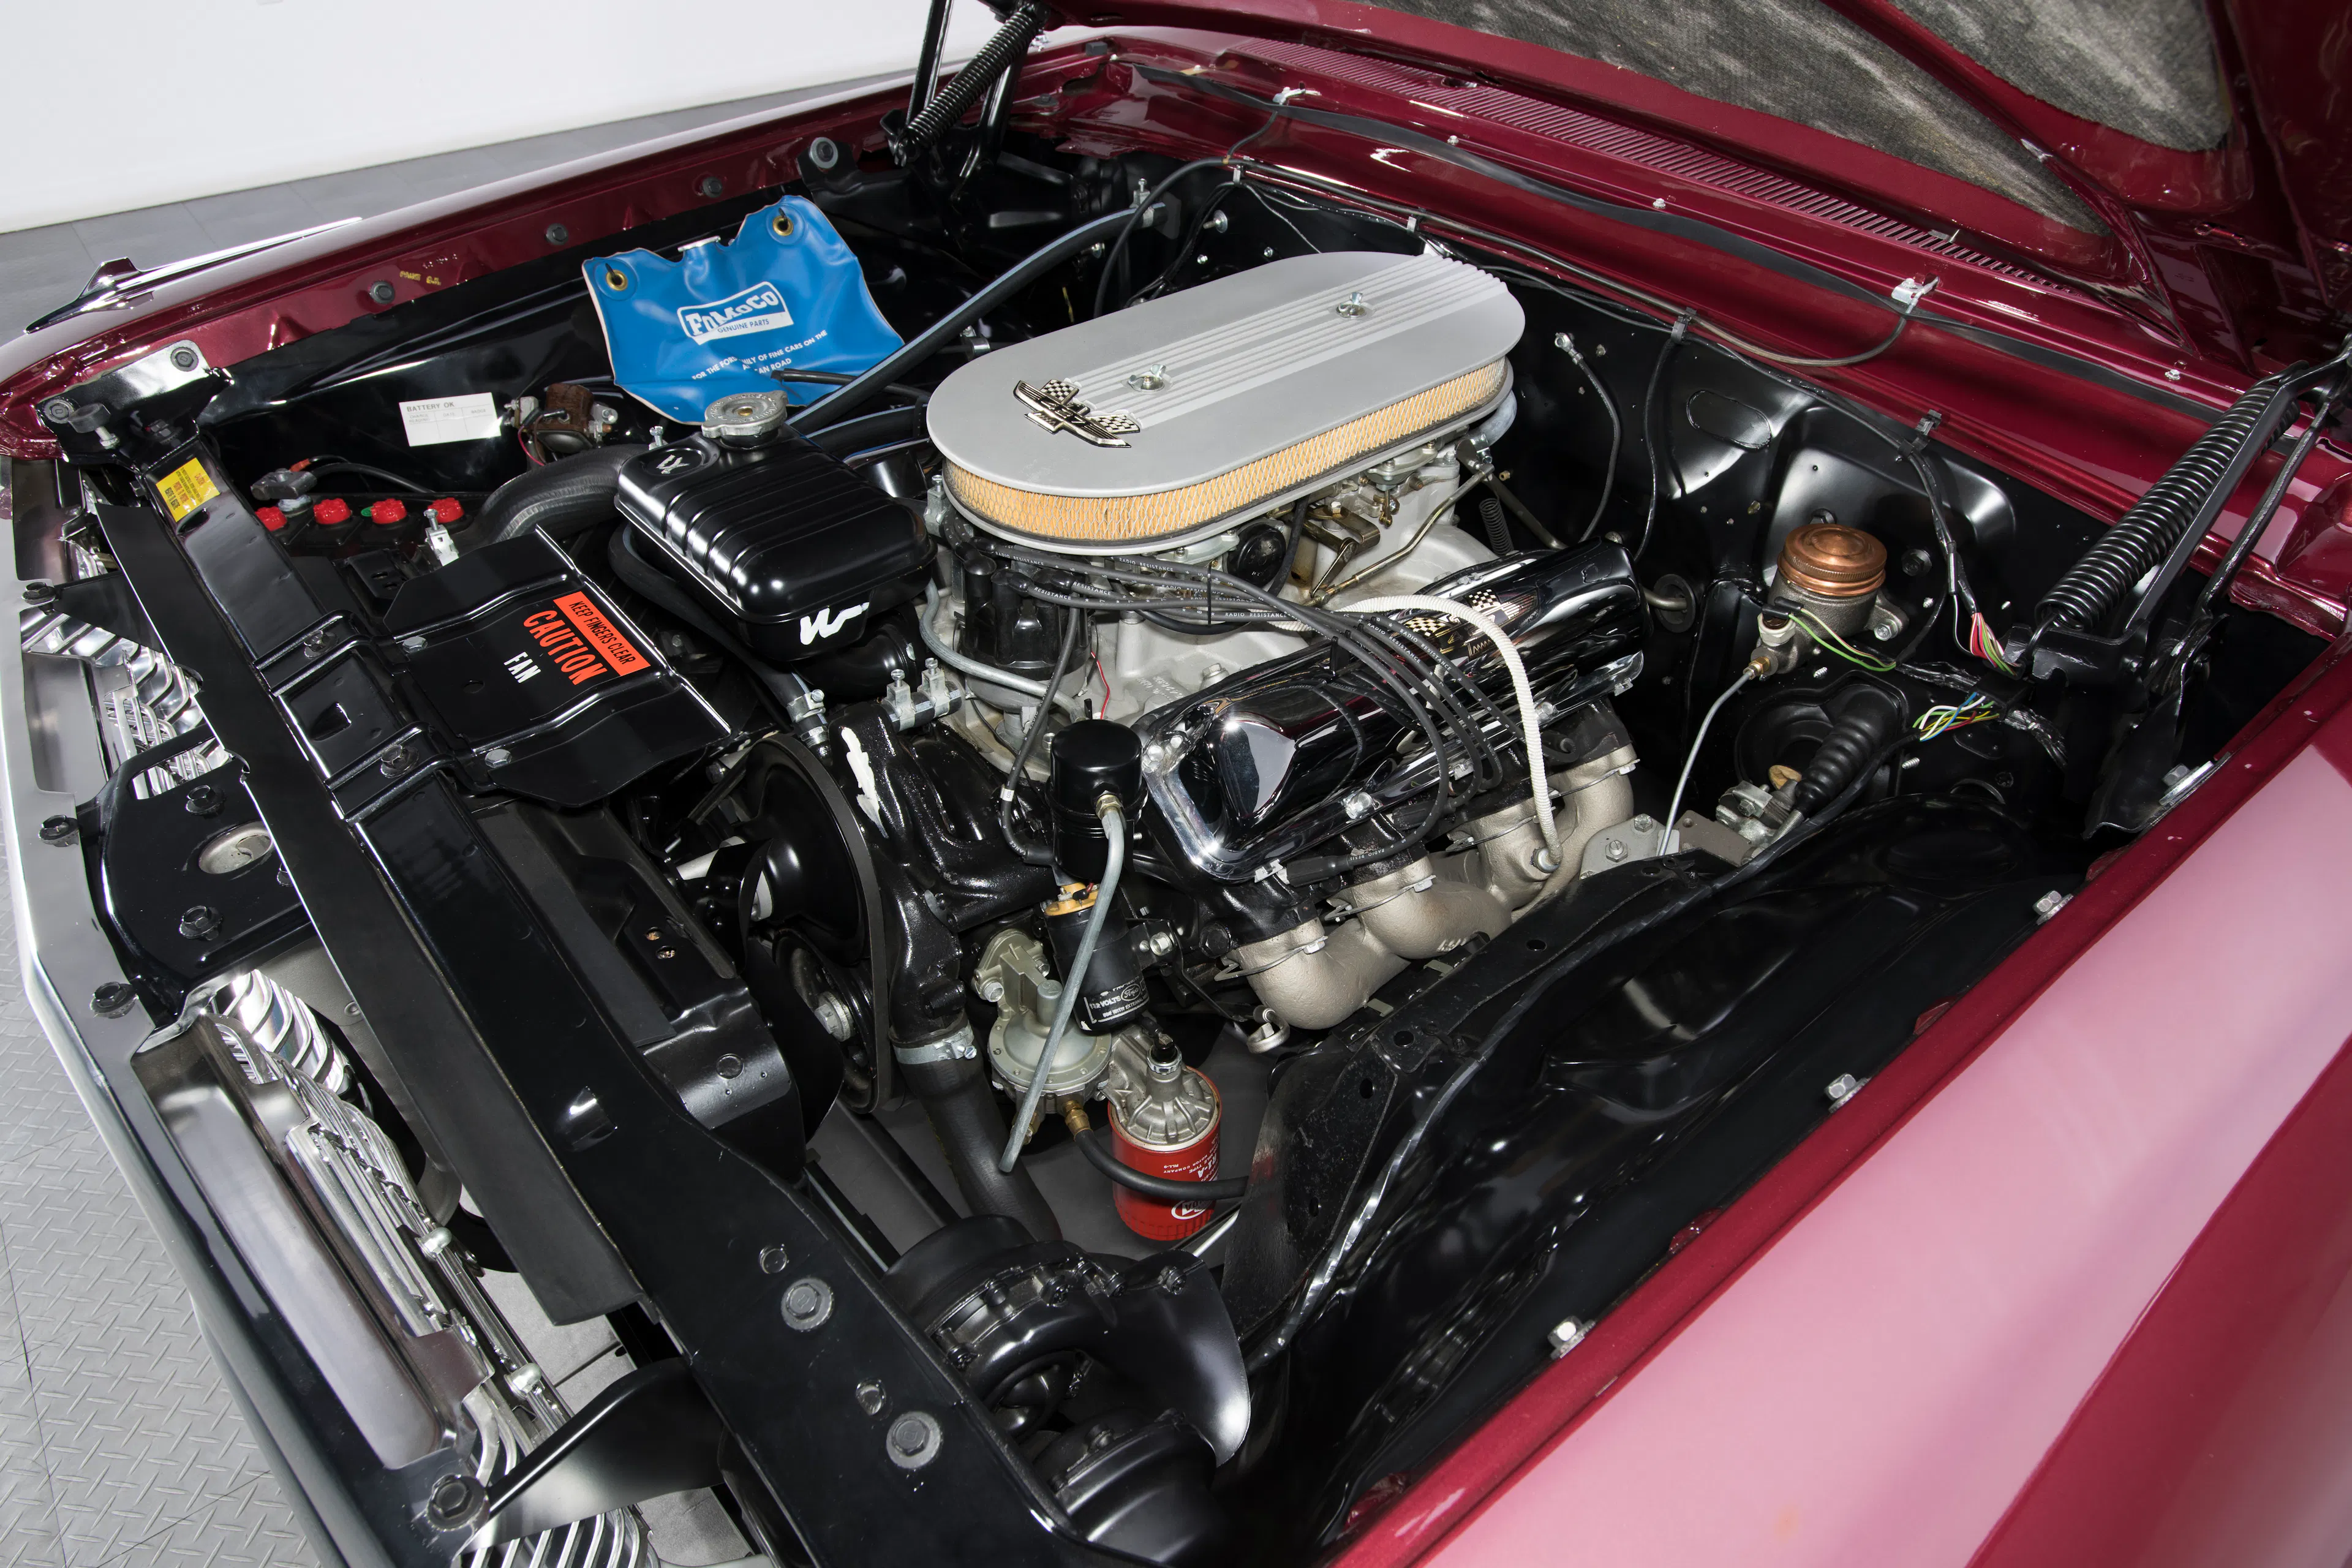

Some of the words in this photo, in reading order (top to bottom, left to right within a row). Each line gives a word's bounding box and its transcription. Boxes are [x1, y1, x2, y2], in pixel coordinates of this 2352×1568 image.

[717, 322, 748, 333] GENUINE
[750, 318, 769, 328] PARTS
[706, 363, 720, 375] THE
[768, 349, 785, 360] FINE
[785, 342, 803, 353] CARS
[804, 337, 815, 346] ON
[815, 330, 827, 341] THE
[770, 358, 792, 371] ROAD
[407, 403, 440, 412] BATTERY
[1013, 556, 1044, 566] RESISTANCE
[1140, 562, 1174, 572] RESISTANCE
[1034, 586, 1071, 600] RESISTANCE
[1072, 581, 1111, 596] RESISTANCE
[568, 601, 594, 619] KEEP
[584, 617, 616, 644] FINGERS
[608, 643, 636, 665] CLEAR
[523, 610, 608, 685] CAUTION
[1367, 622, 1386, 635] RADIO
[1389, 636, 1422, 664] RESISTANCE
[1400, 628, 1418, 643] RADIO
[1420, 643, 1452, 671] RESISTANCE
[503, 652, 541, 684] FAN
[1100, 995, 1121, 1008] VOLTS
[1192, 1155, 1208, 1166] MOTOR
[1163, 1165, 1190, 1174] COMPANY
[1188, 1164, 1202, 1174] TYPE
